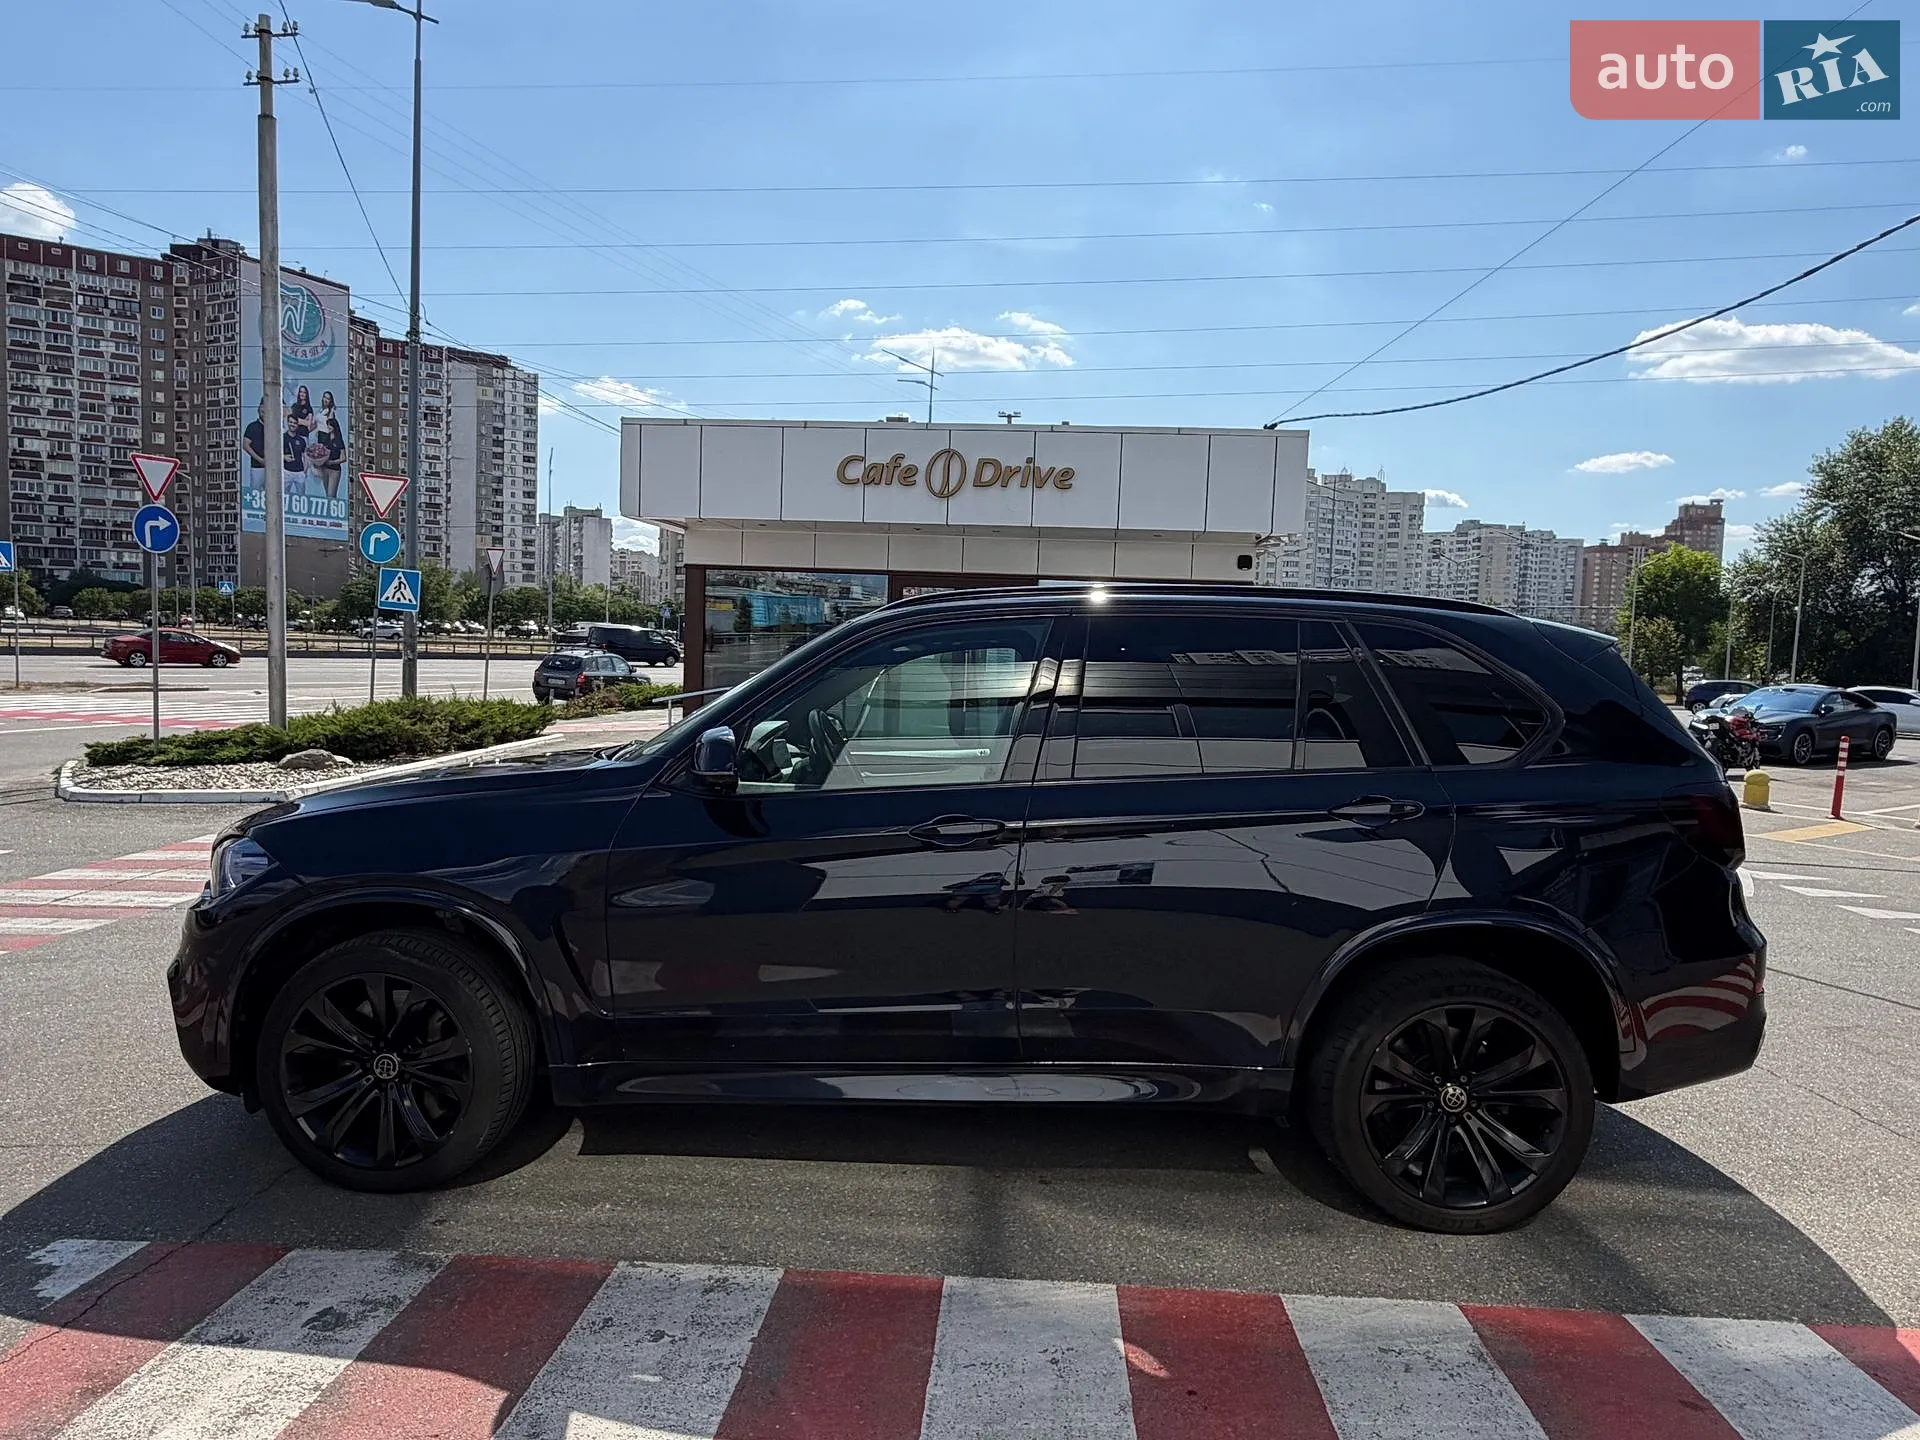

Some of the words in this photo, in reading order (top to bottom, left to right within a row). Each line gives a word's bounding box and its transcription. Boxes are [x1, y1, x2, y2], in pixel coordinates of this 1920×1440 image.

[836, 453, 919, 487] Cafe
[972, 457, 1076, 490] Drive
[291, 494, 308, 514] 60
[309, 497, 329, 516] 777
[329, 499, 346, 518] 60
